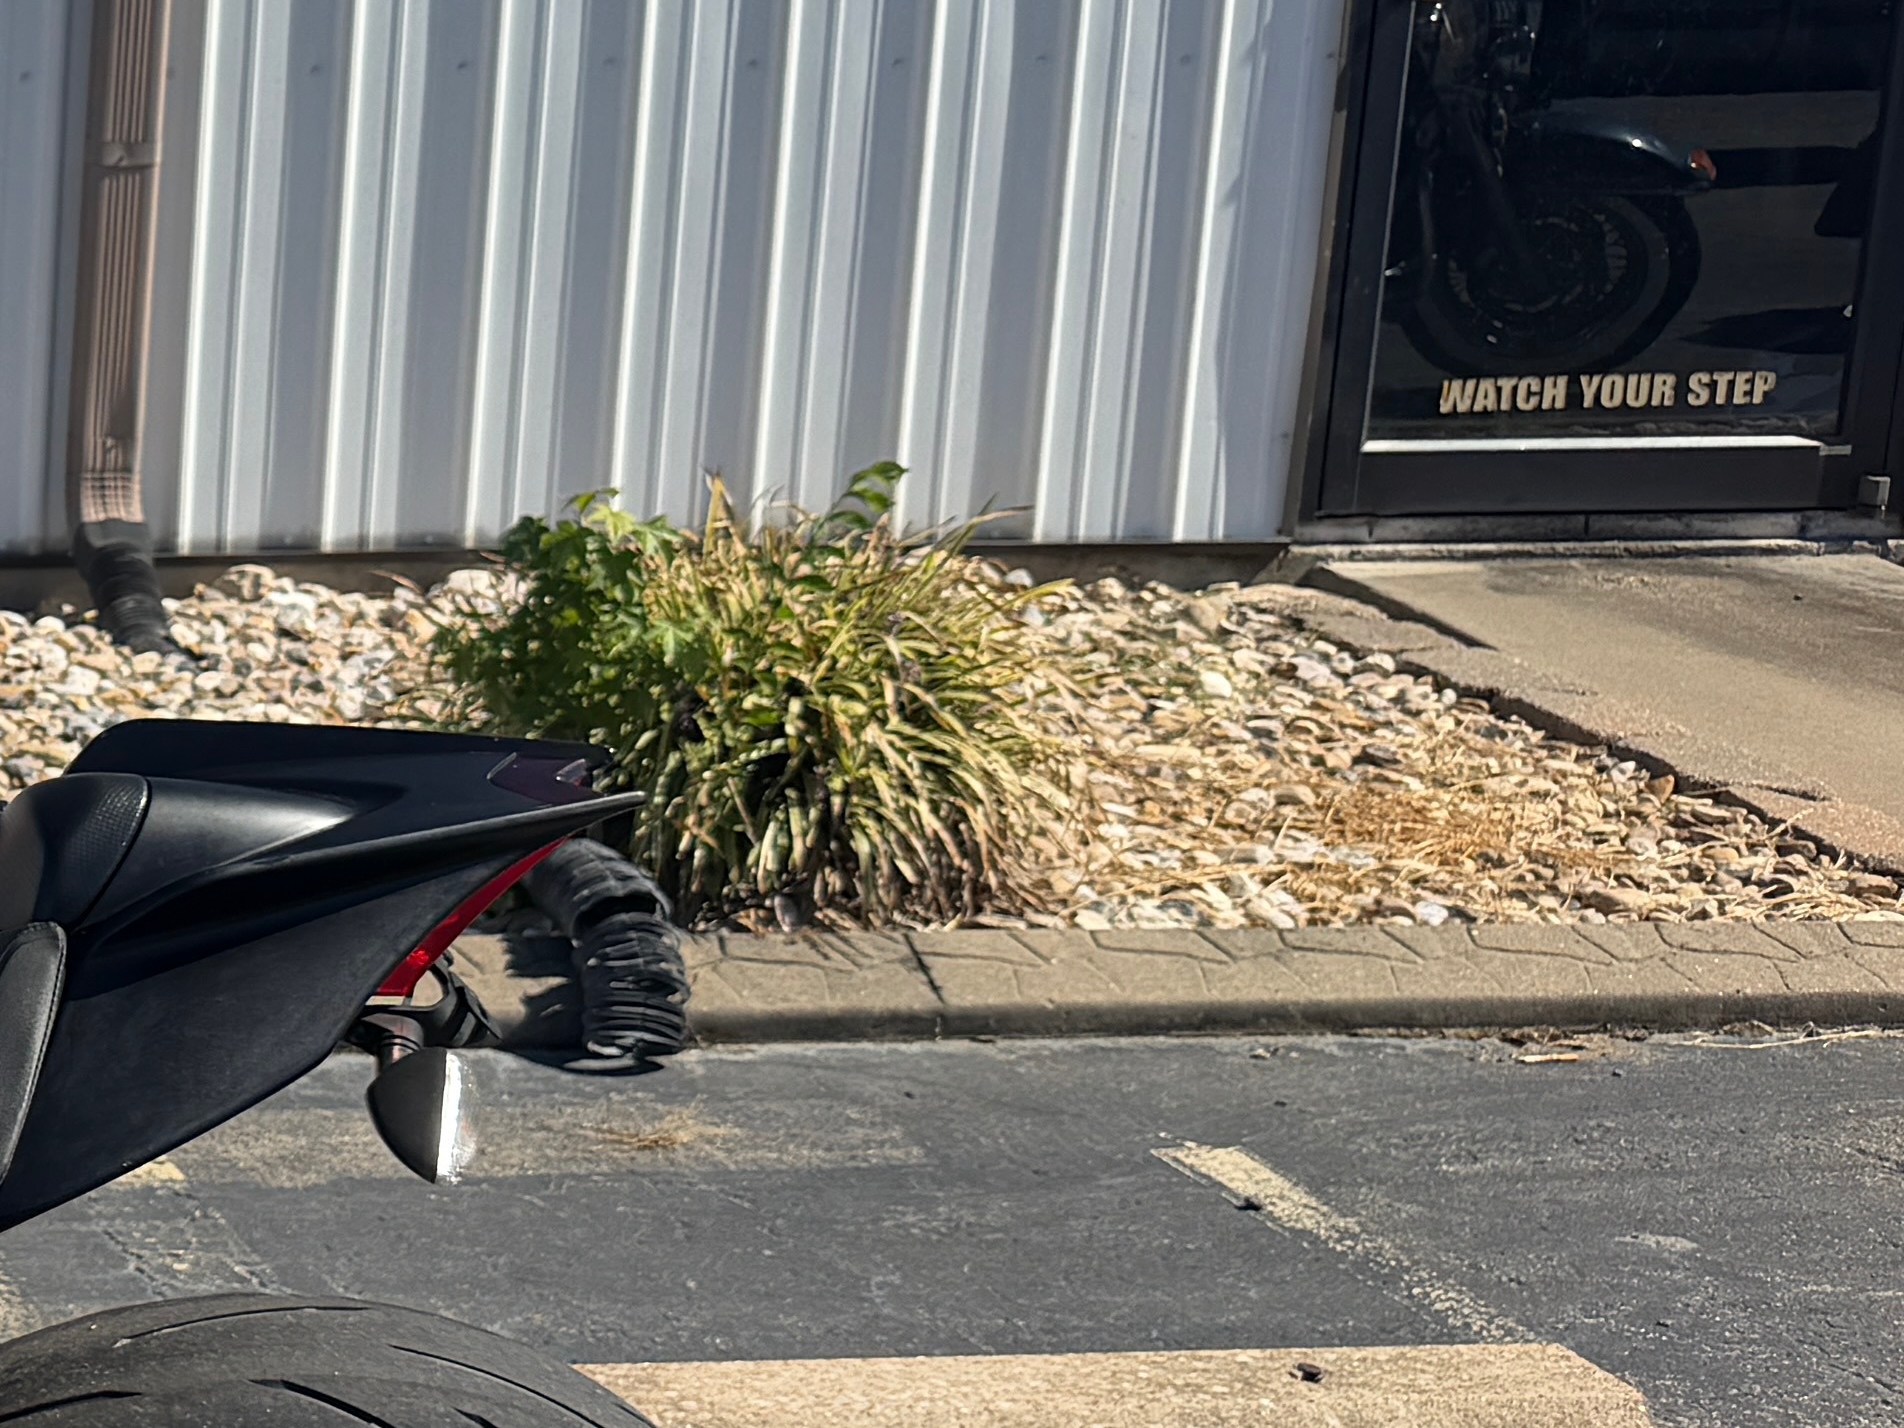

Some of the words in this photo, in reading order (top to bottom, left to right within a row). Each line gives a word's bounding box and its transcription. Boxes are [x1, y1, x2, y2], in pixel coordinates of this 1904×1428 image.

[1439, 375, 1569, 414] WATCH
[1580, 373, 1677, 409] YOUR
[1687, 371, 1777, 406] STEP
